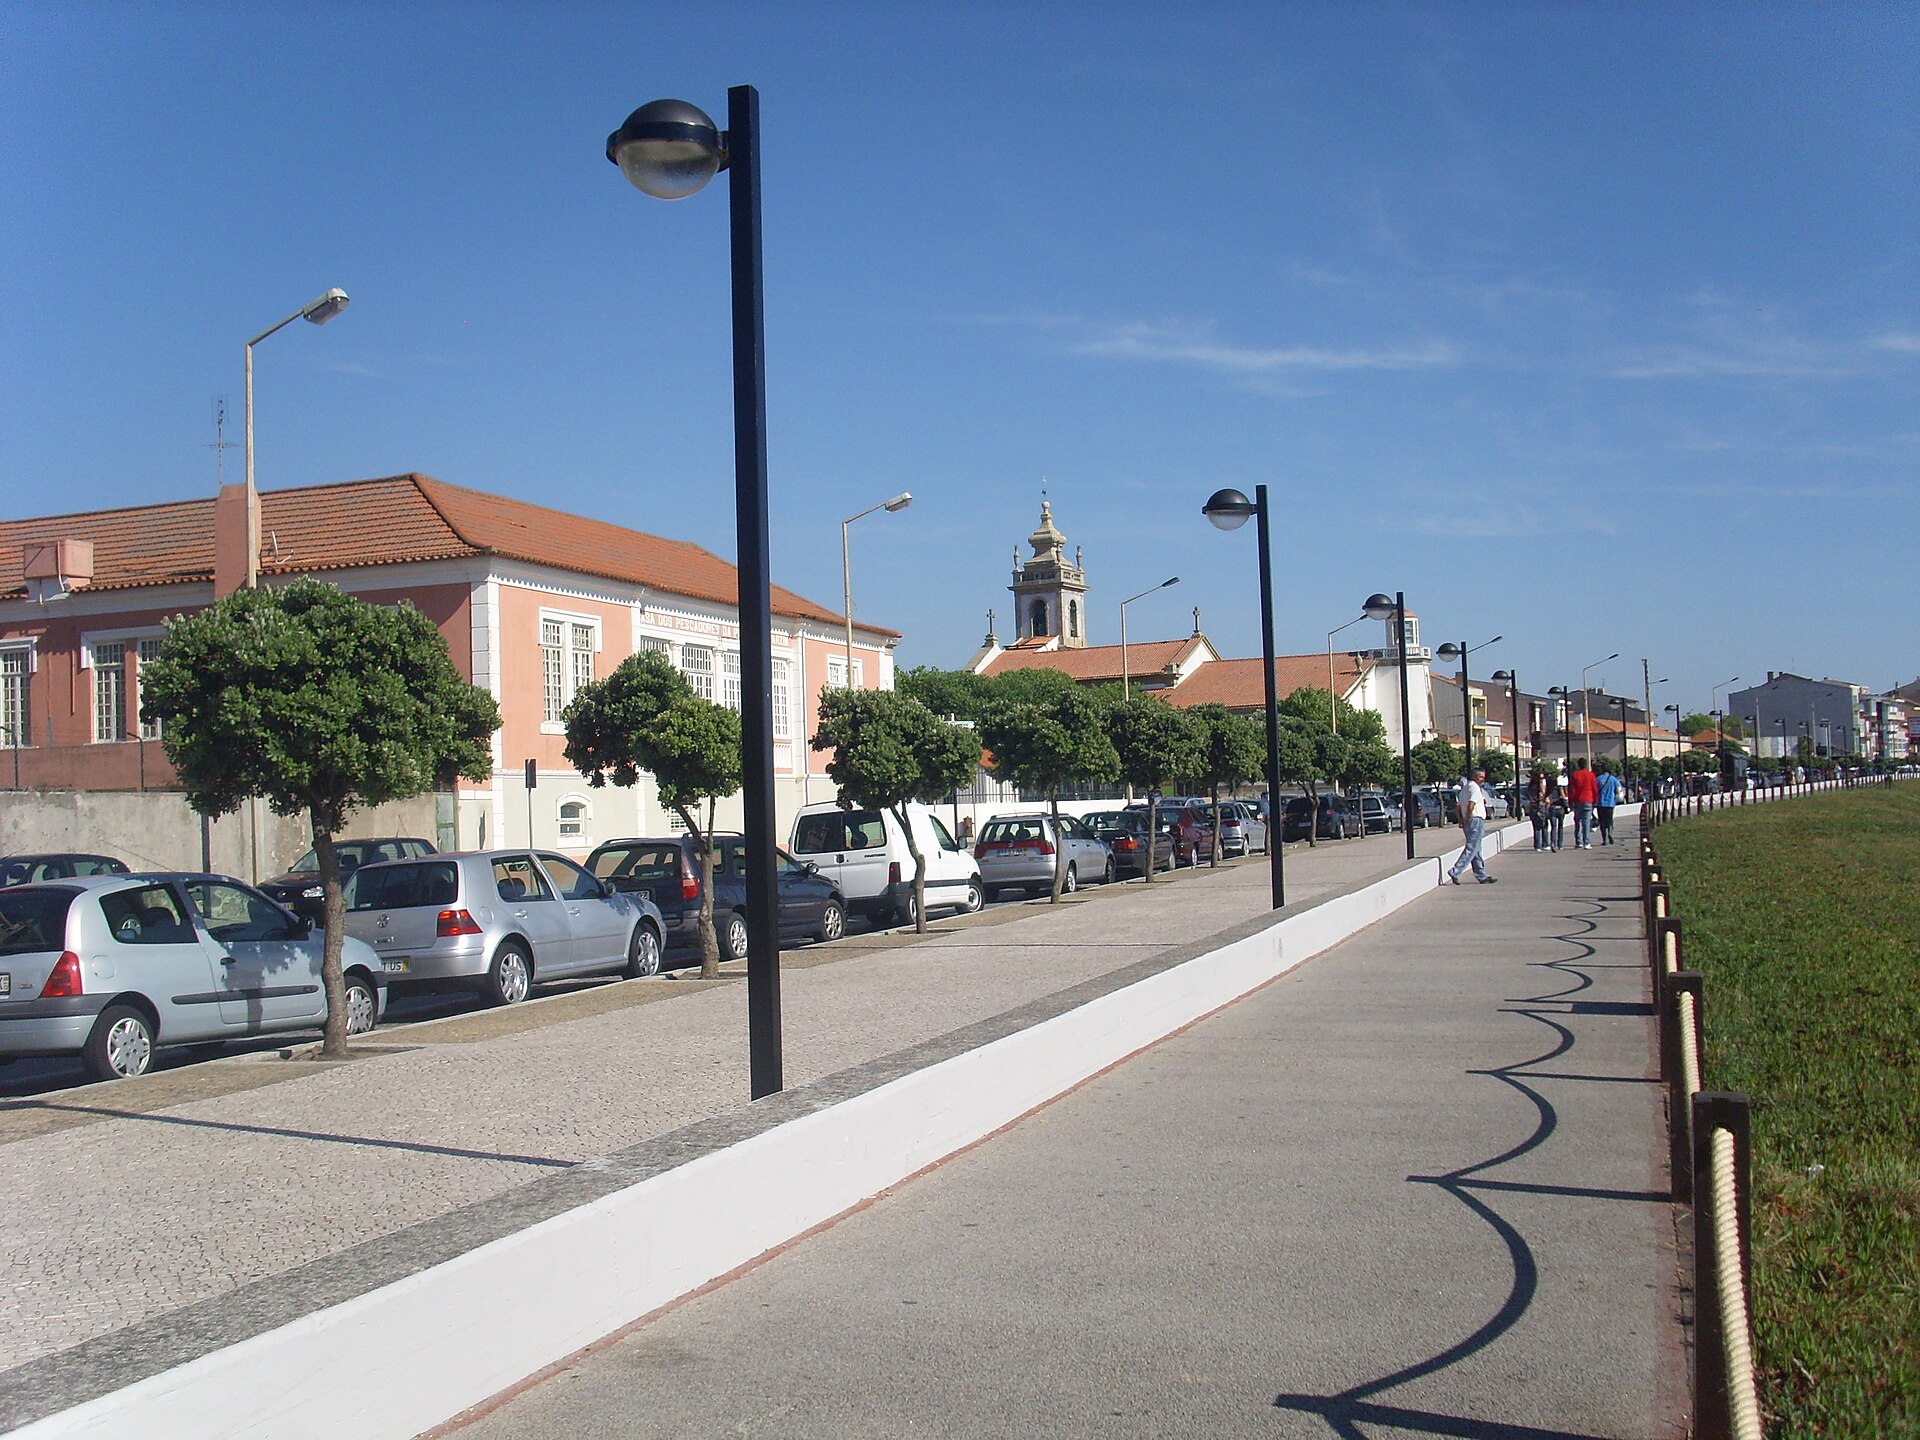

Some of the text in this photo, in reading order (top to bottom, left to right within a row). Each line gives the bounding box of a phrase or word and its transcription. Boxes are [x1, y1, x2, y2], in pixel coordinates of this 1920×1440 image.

[640, 612, 655, 625] ASA
[658, 614, 673, 627] DOS
[675, 617, 720, 636] PESCADORES
[722, 625, 732, 638] DA
